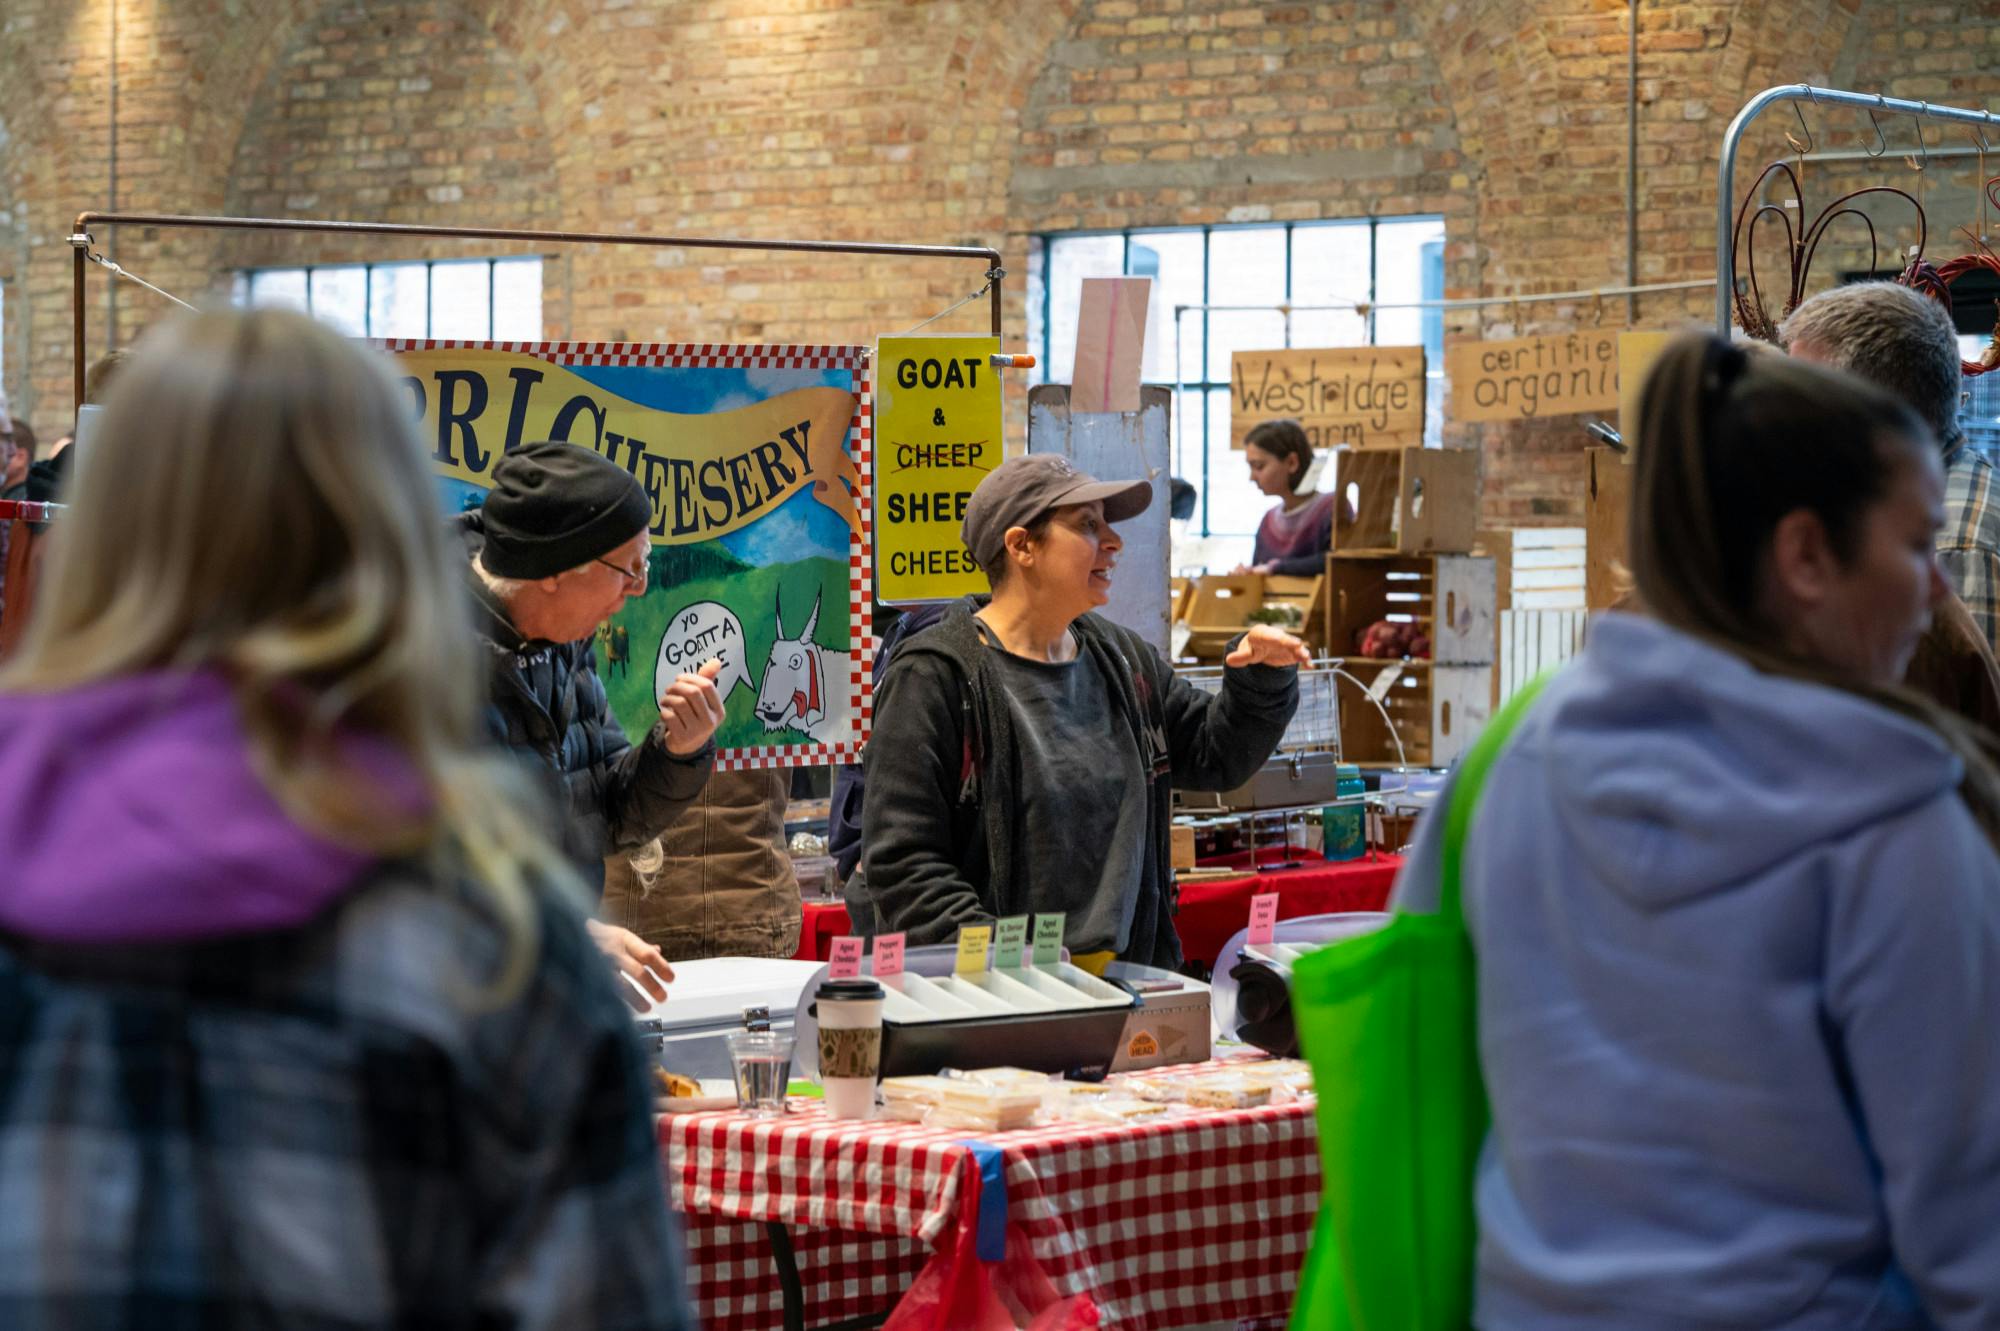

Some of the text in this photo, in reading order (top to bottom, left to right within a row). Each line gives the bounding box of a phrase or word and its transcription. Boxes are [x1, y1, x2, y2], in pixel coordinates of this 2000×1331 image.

[1482, 334, 1619, 374] certifie
[897, 358, 982, 389] GOAT
[1236, 358, 1409, 430] Westridge
[1474, 362, 1619, 417] organi
[932, 407, 946, 426] &
[1298, 416, 1365, 448] arm
[897, 443, 983, 468] CHEEP
[888, 491, 972, 524] SHEE
[891, 550, 984, 576] CHEES
[681, 613, 699, 632] YO
